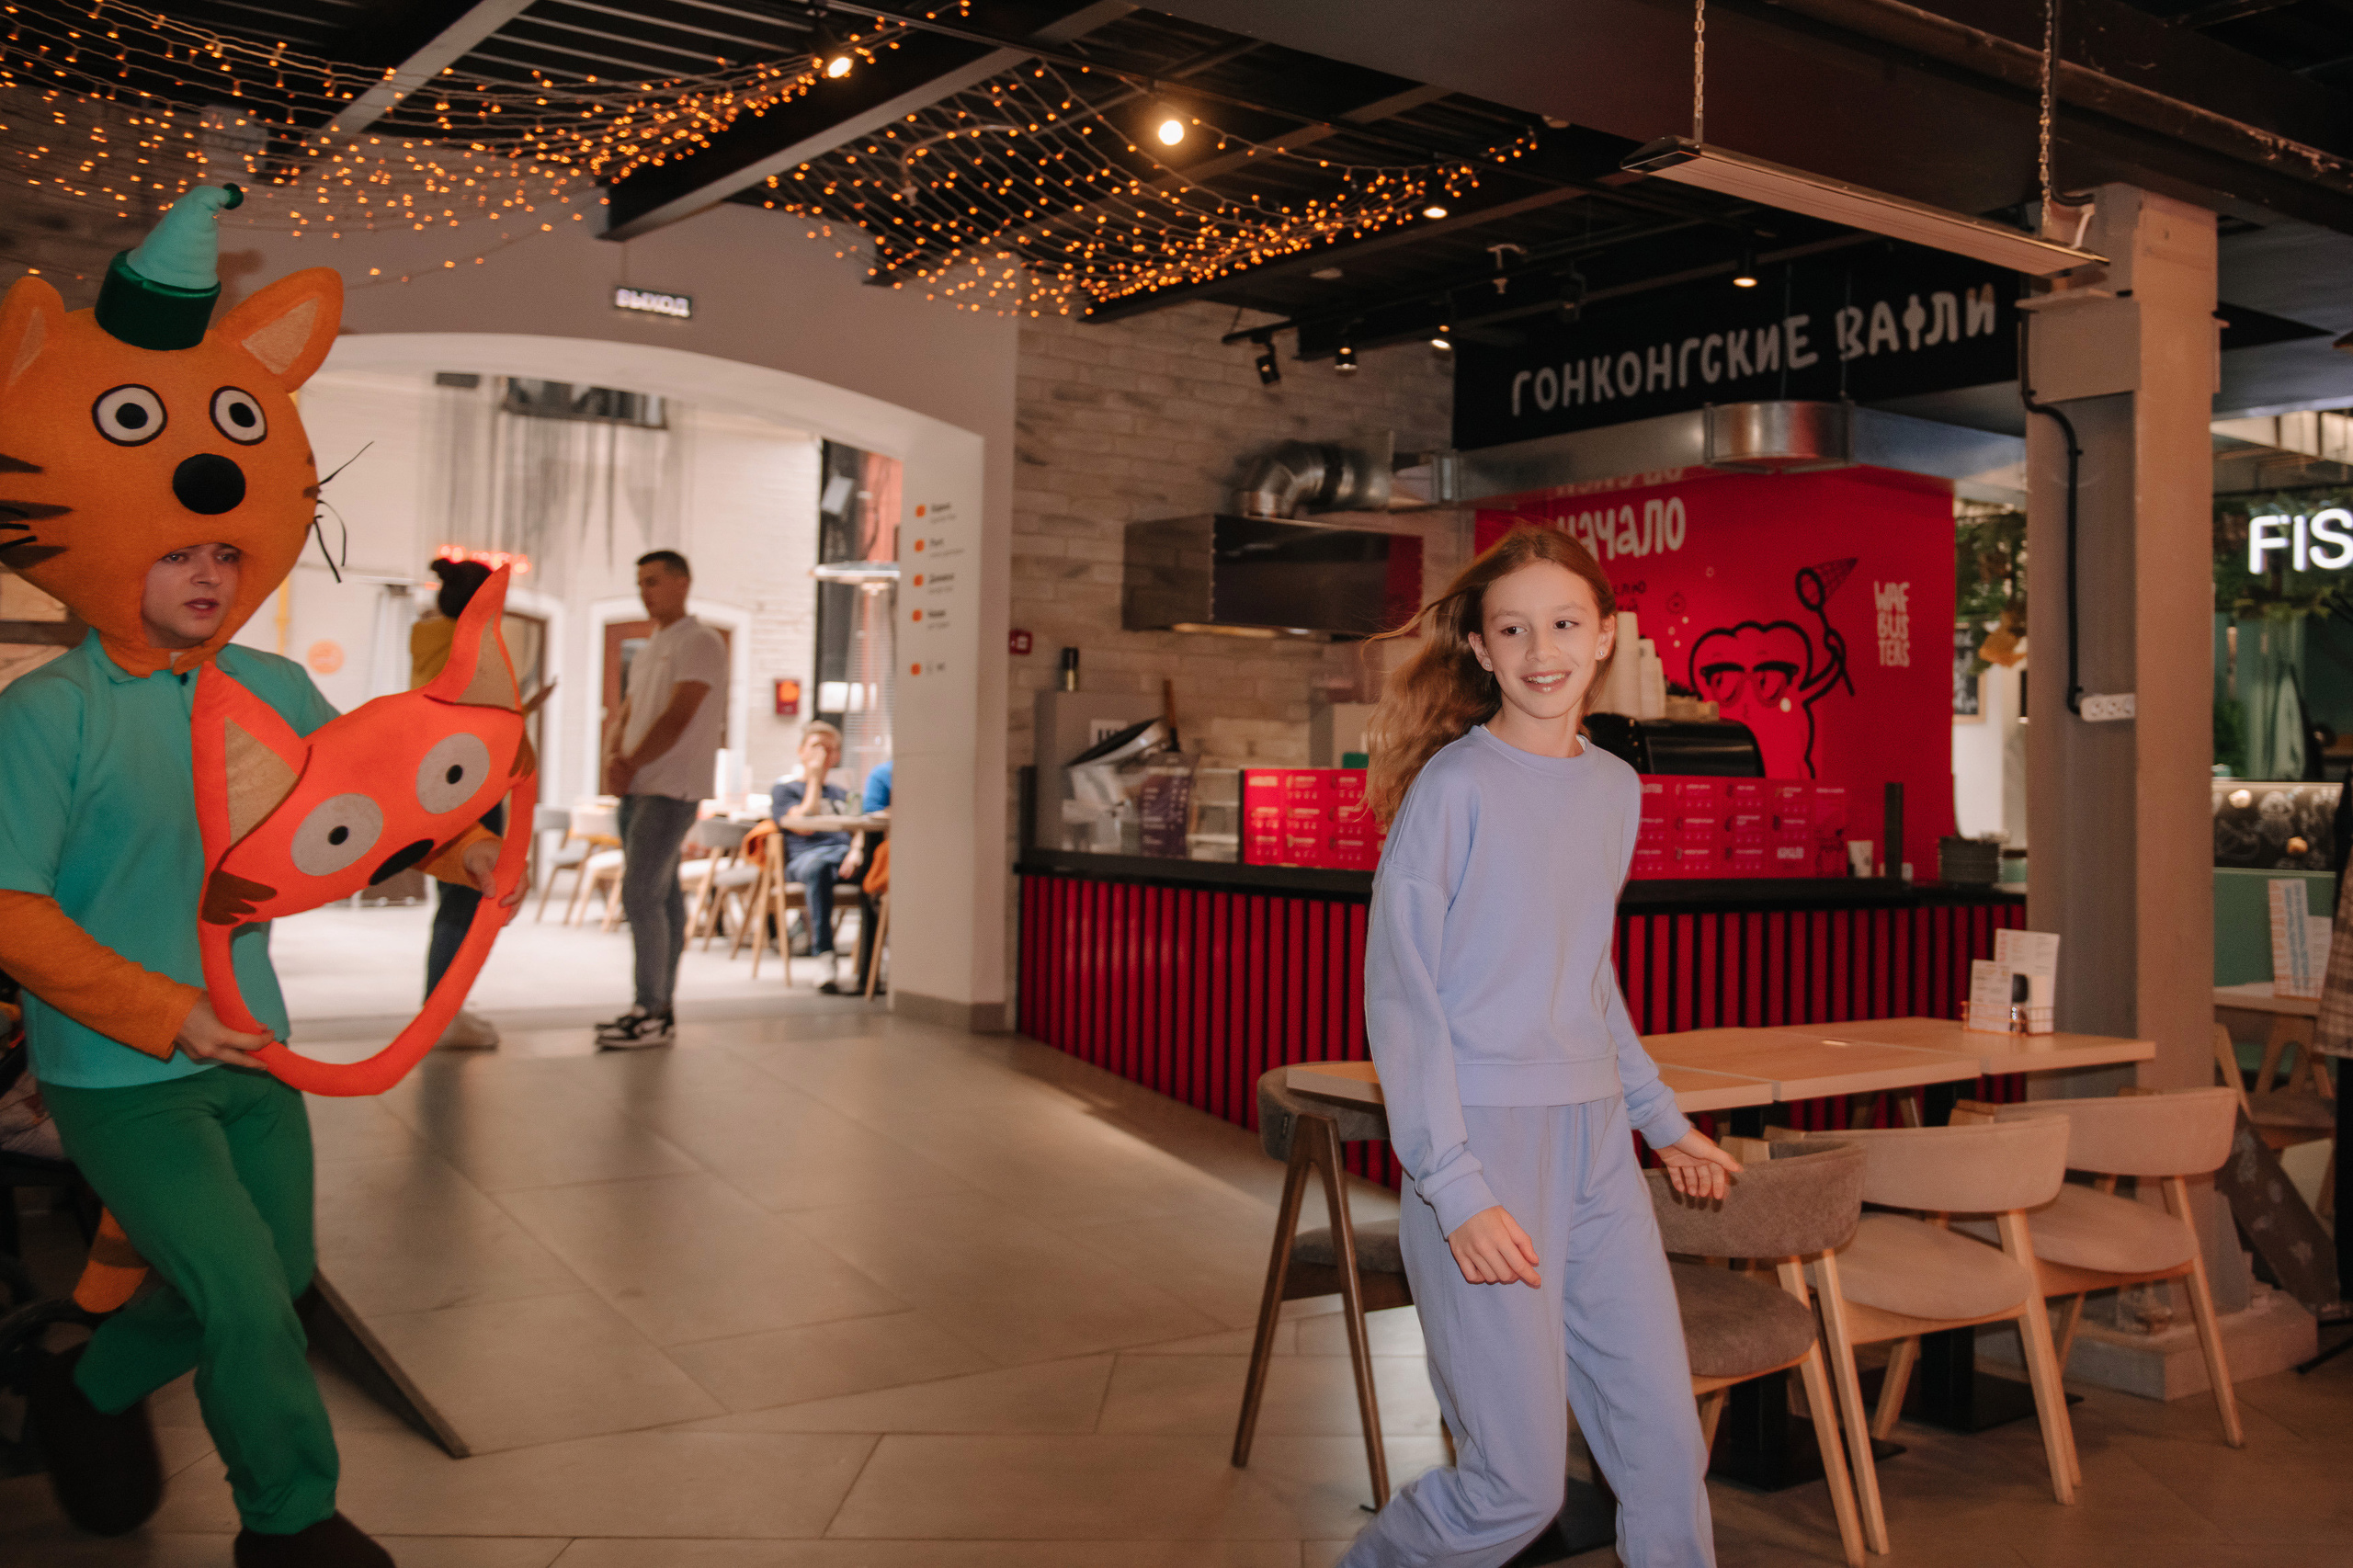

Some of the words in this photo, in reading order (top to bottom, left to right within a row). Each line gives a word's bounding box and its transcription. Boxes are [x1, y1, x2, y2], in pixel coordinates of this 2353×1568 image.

[616, 288, 690, 318] ВЫХОД
[1511, 313, 1819, 417] ГОНКОНГСКИЕ
[1835, 282, 1997, 362] ВАФЛИ
